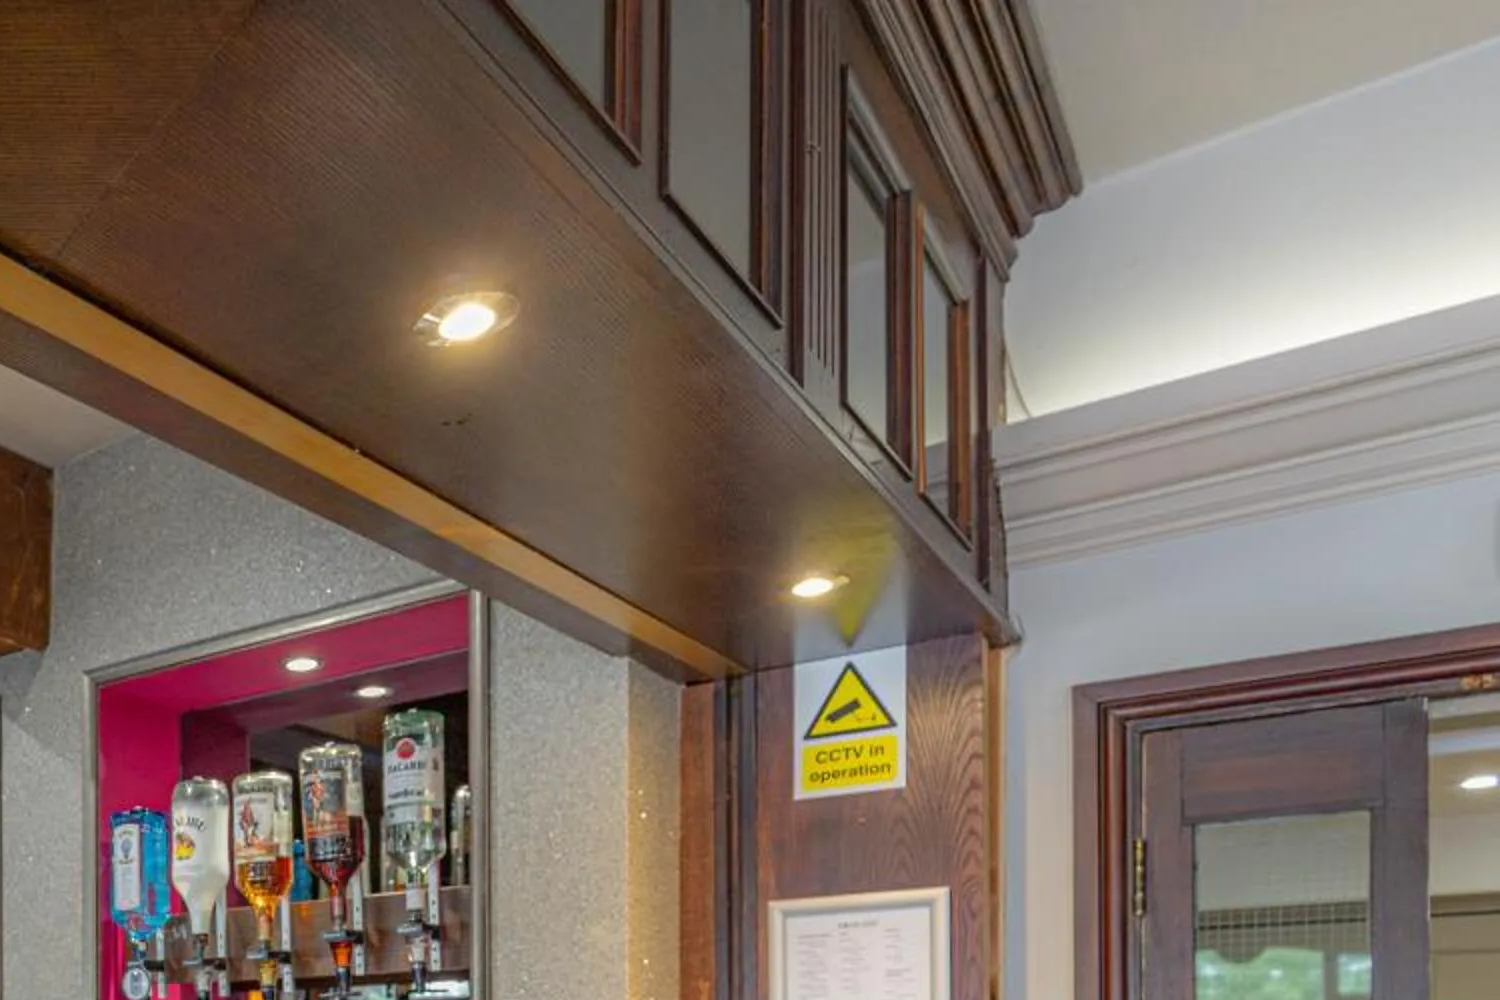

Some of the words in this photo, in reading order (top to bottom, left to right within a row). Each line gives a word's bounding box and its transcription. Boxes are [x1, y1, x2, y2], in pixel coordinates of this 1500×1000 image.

[815, 745, 864, 765] CCTV
[868, 743, 885, 757] in
[809, 762, 892, 784] operation
